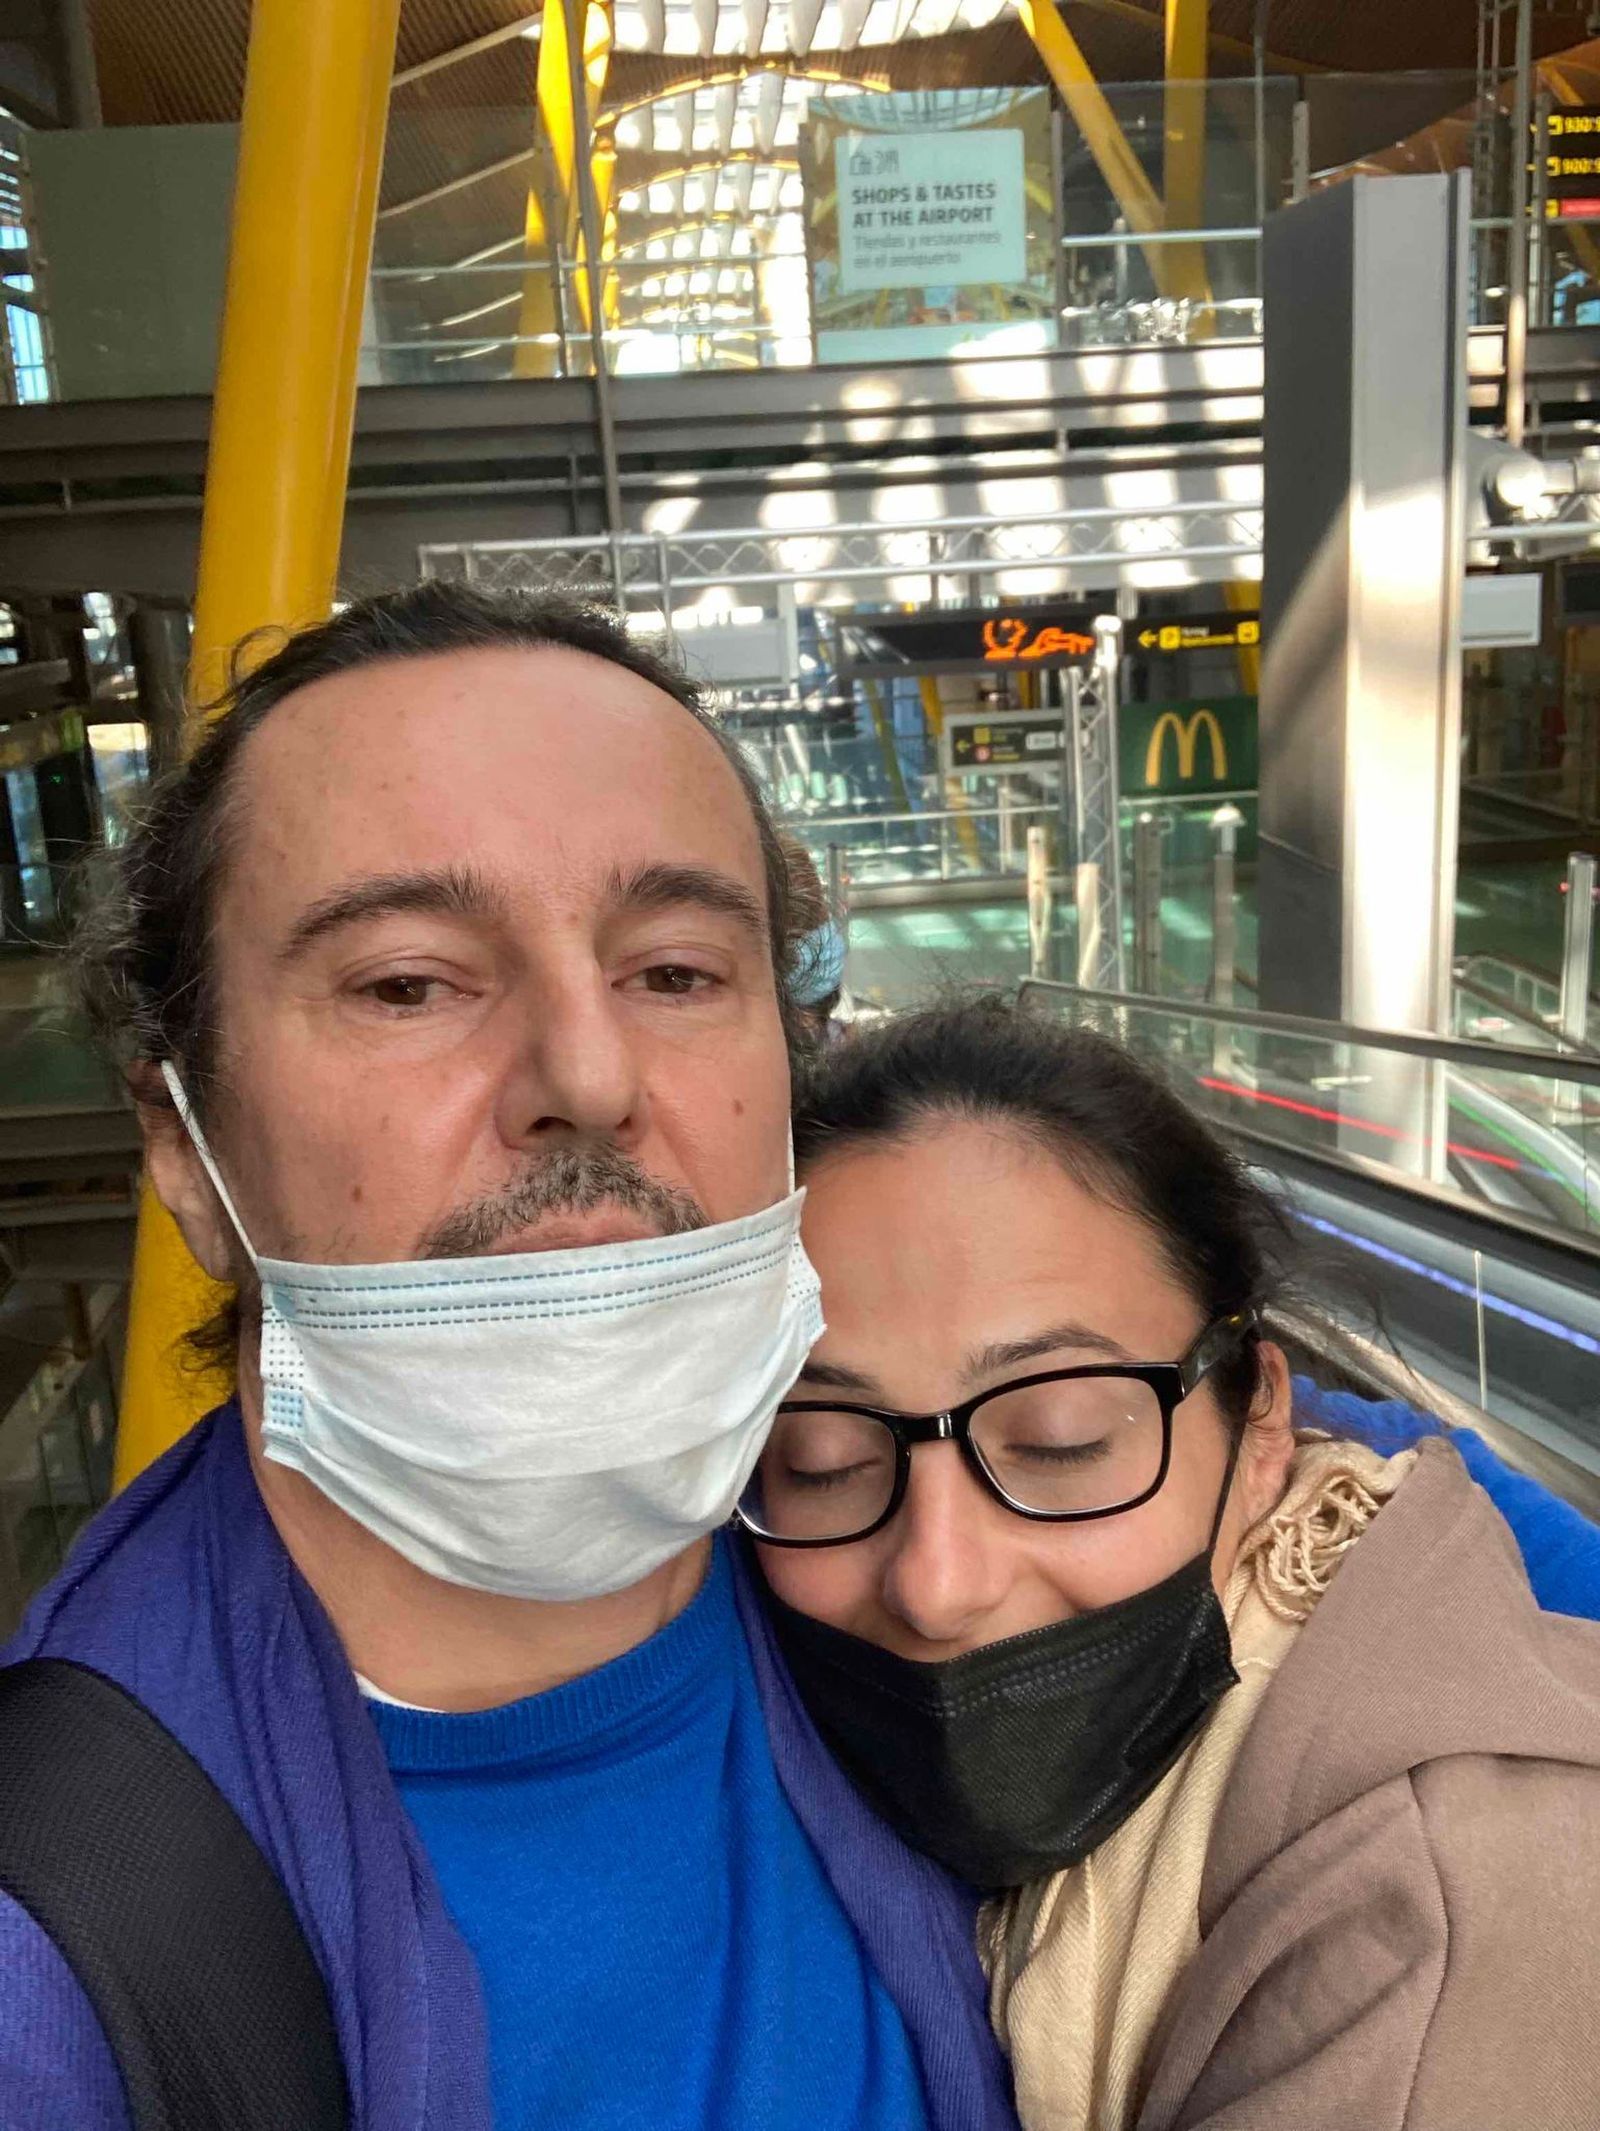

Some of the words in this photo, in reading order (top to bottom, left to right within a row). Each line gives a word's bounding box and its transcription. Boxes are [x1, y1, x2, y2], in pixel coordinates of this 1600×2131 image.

[852, 186, 910, 204] SHOPS
[915, 185, 928, 202] &
[933, 183, 996, 201] TASTES
[853, 211, 873, 228] AT
[879, 210, 912, 226] THE
[918, 207, 993, 224] AIRPORT
